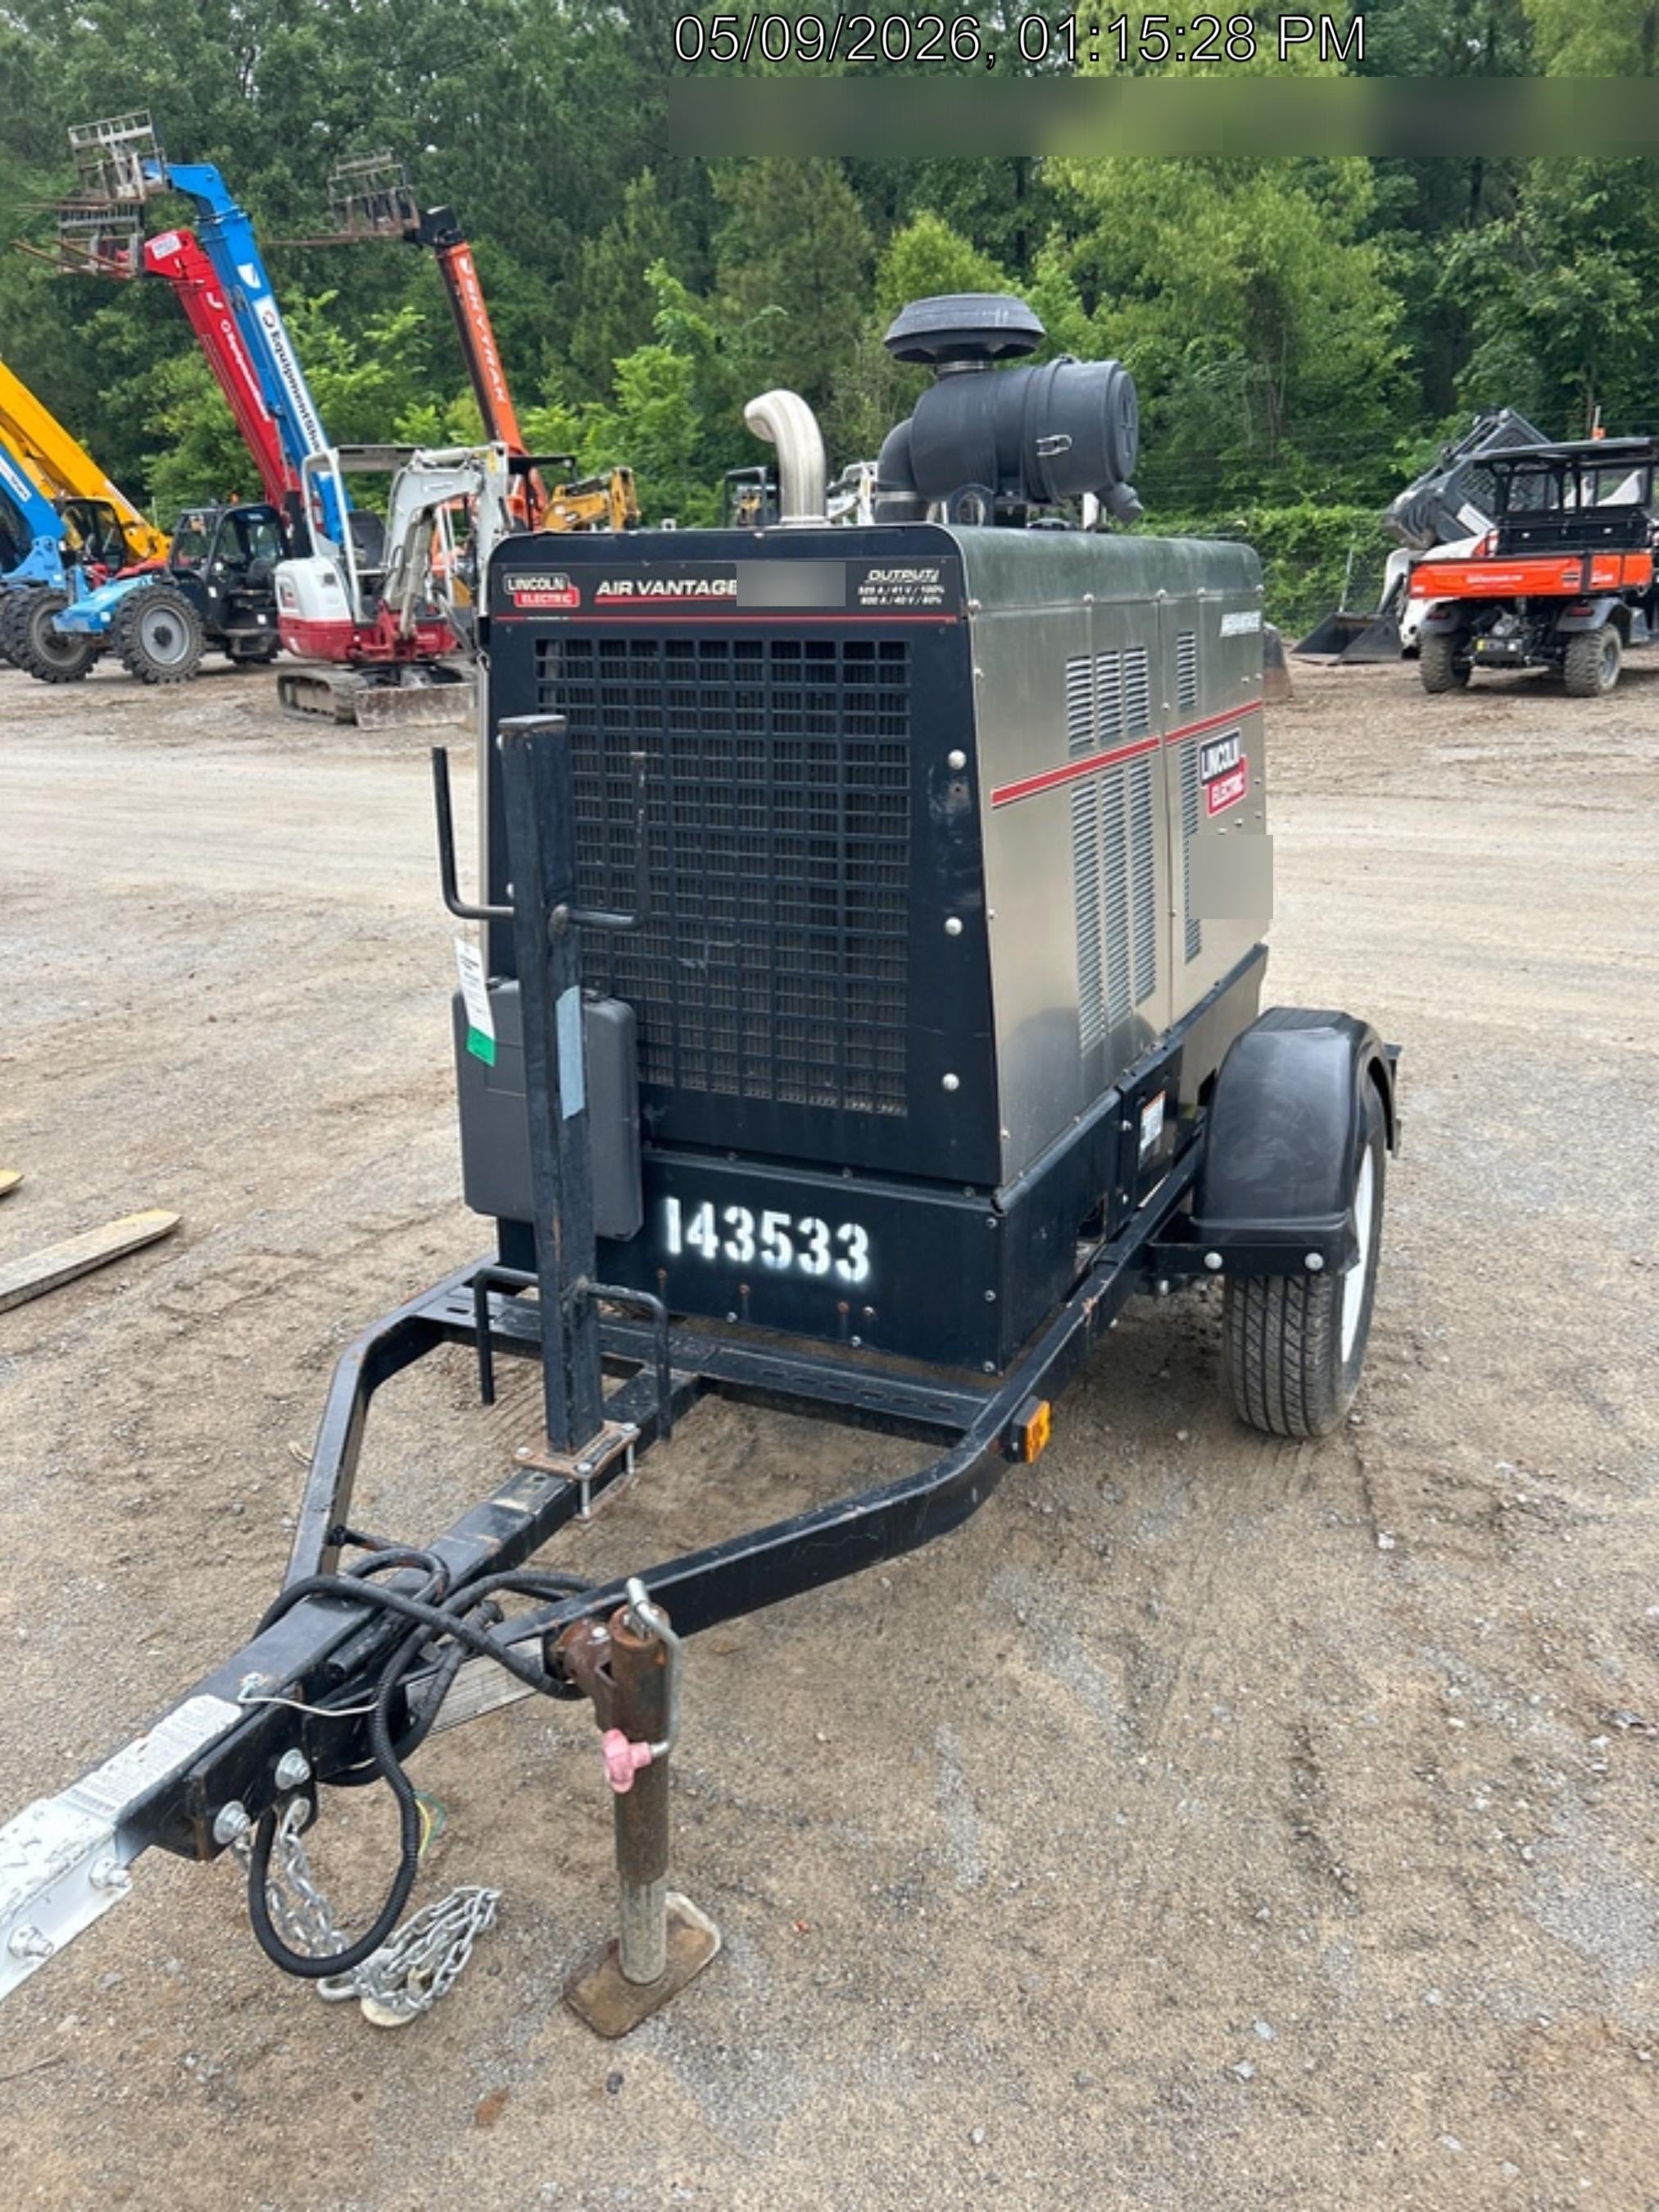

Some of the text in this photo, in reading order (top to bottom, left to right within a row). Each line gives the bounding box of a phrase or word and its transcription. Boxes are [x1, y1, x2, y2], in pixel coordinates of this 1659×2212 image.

[507, 576, 566, 592] LINCOLN
[596, 579, 637, 596] AIR
[521, 592, 573, 604] ELECTRIC
[664, 1196, 870, 1282] 143533
